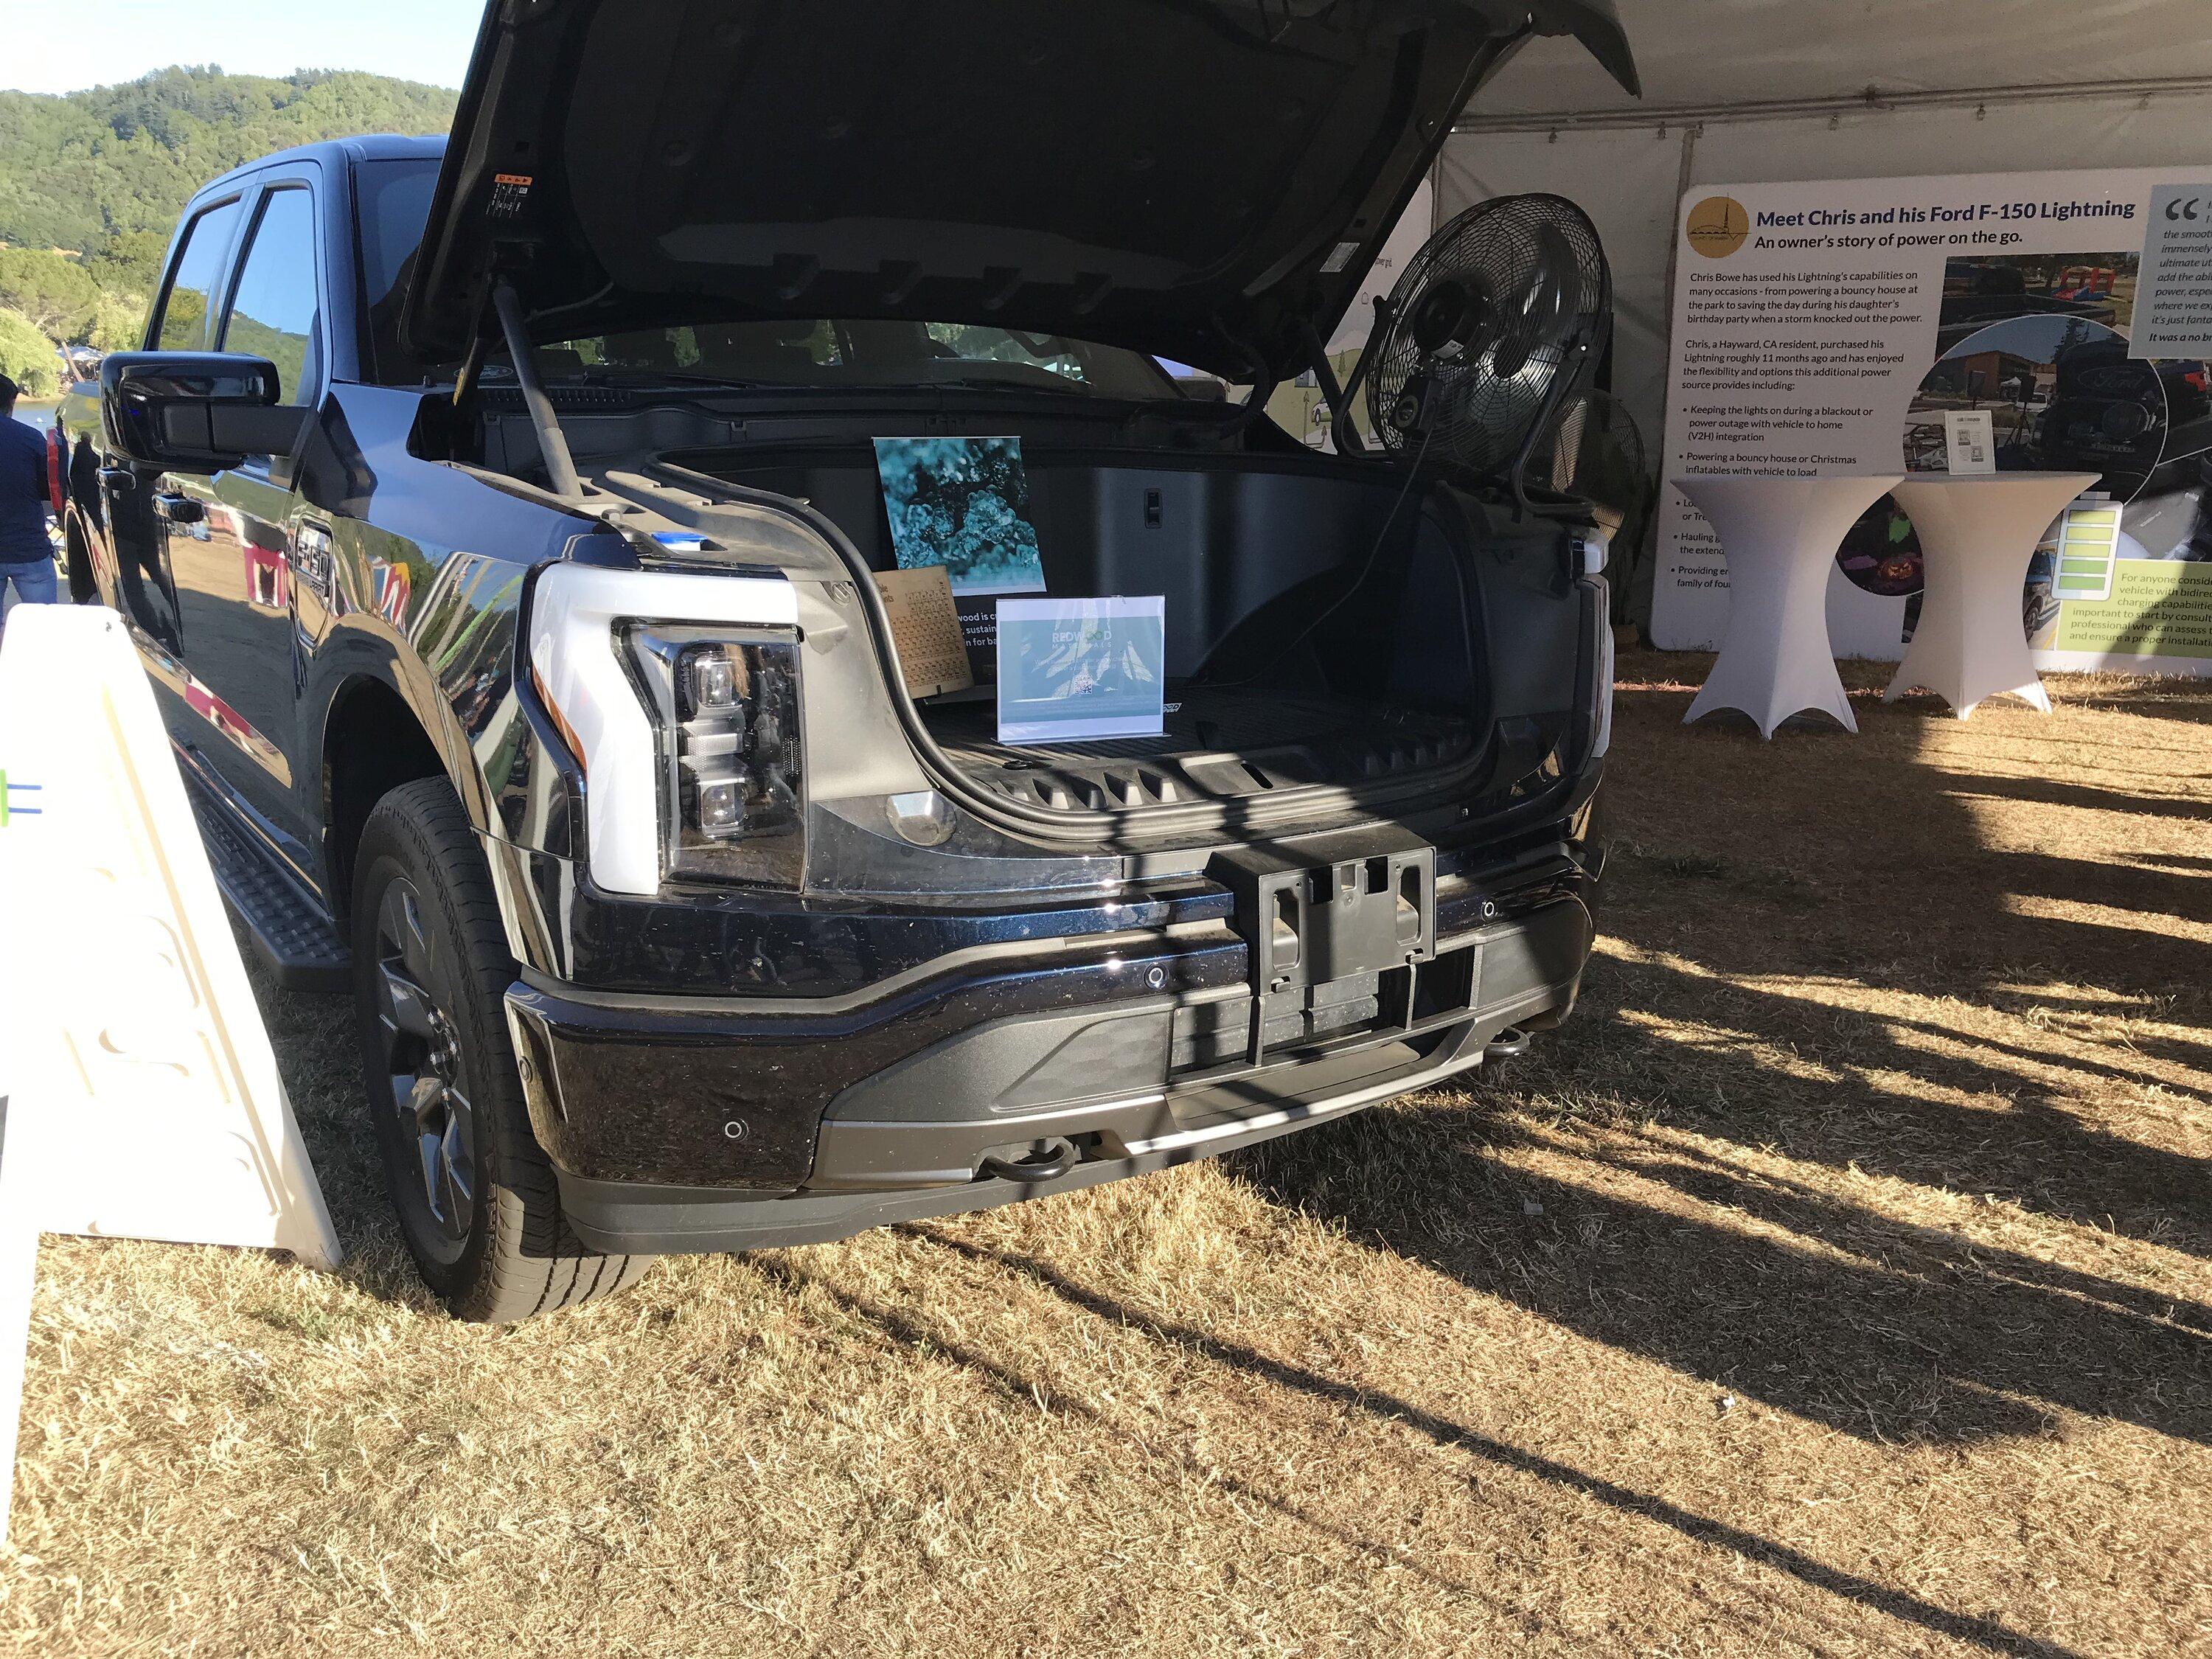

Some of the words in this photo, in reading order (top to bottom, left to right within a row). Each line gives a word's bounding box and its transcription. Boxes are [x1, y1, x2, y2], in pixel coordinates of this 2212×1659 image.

[1757, 212, 1804, 226] Meet
[1808, 209, 1856, 226] Chris
[1860, 208, 1895, 224] and
[1899, 207, 1926, 223] his
[1930, 205, 1975, 222] Ford
[1979, 203, 2037, 220] F-150
[2041, 201, 2136, 221] Lightning
[1755, 236, 1774, 248] An
[1837, 235, 1876, 249] story
[1879, 233, 1895, 246] of
[1896, 235, 1945, 248] power
[1949, 234, 1967, 244] on
[1972, 230, 1997, 243] the
[2000, 233, 2023, 245] go.
[2164, 230, 2180, 239] the
[2181, 230, 2212, 239] smoot
[2160, 258, 2200, 268] ultimate
[1690, 273, 1714, 282] Chris
[1716, 273, 1740, 282] Bowe
[1742, 273, 1758, 282] has
[1759, 273, 1781, 282] used
[1783, 273, 1795, 282] his
[1849, 271, 1903, 282] capabilities
[2157, 272, 2177, 282] add
[2178, 273, 2194, 282] the
[1689, 289, 1714, 297] many
[1715, 287, 1758, 296] occasions
[1764, 287, 1787, 295] from
[1789, 286, 1832, 297] powering
[1841, 286, 1876, 296] bouncy
[2155, 289, 2187, 297] power,
[1688, 301, 1703, 310] the
[1705, 301, 1724, 311] park
[1727, 302, 1736, 310] to
[1737, 301, 1766, 311] saving
[1768, 301, 1782, 309] the
[1784, 301, 1801, 310] day
[1802, 301, 1832, 310] during
[1834, 301, 1847, 309] his
[2154, 301, 2183, 310] where
[1687, 314, 1725, 324] birthday
[1725, 316, 1750, 324] party
[1751, 315, 1775, 323] when
[1814, 314, 1852, 323] knocked
[1854, 314, 1871, 323] out
[1873, 314, 1888, 322] the
[1890, 316, 1921, 324] power.
[2166, 317, 2185, 326] just
[2149, 333, 2157, 341] It
[1686, 340, 1711, 349] Chris,
[1719, 340, 1761, 349] Hayward,
[1779, 340, 1818, 349] resident,
[1820, 340, 1868, 350] purchased
[1871, 340, 1884, 348] his
[1685, 353, 1725, 364] Lightning
[1726, 354, 1761, 364] roughly
[1762, 354, 1773, 362] 11
[1775, 354, 1809, 362] months
[1811, 356, 1828, 364] ago
[1830, 354, 1847, 363] and
[1848, 354, 1865, 363] has
[1867, 354, 1904, 364] enjoyed
[1683, 367, 1697, 375] the
[1699, 367, 1740, 377] flexibility
[1741, 367, 1758, 375] and
[1759, 367, 1793, 378] options
[1795, 368, 1812, 376] this
[1813, 367, 1860, 376] additional
[1712, 380, 1750, 390] provides
[1752, 381, 1795, 391] including:
[1691, 406, 1726, 416] Keeping
[1728, 406, 1742, 414] the
[1745, 406, 1768, 416] lights
[1783, 406, 1812, 417] during
[1822, 407, 1861, 416] blackout
[1719, 420, 1749, 429] outage
[1750, 420, 1770, 428] with
[1773, 420, 1804, 428] vehicle
[1817, 420, 1843, 429] home
[1688, 431, 1714, 441] (V2H)
[1716, 432, 1764, 442] integration
[1687, 453, 1728, 463] Powering
[1736, 453, 1768, 463] bouncy
[1770, 454, 1797, 463] house
[1811, 455, 1857, 464] Christmas
[1686, 465, 1731, 475] inflatables
[1732, 467, 1752, 475] with
[1753, 467, 1784, 476] vehicle
[1787, 468, 1796, 476] to
[1798, 467, 1817, 476] load
[1681, 532, 1714, 543] Hauling
[1680, 546, 1694, 554] the
[1678, 566, 1718, 577] Providing
[2121, 574, 2138, 582] For
[1677, 579, 1703, 588] family
[2120, 585, 2154, 594] vehicle
[2156, 588, 2178, 597] with
[2118, 597, 2160, 609] charging
[981, 612, 989, 621] is
[2073, 608, 2122, 618] important
[2136, 612, 2160, 622] start
[2161, 611, 2174, 622] by
[2070, 619, 2130, 630] professional
[2132, 623, 2154, 632] who
[973, 638, 986, 646] for
[2132, 636, 2166, 644] proper
